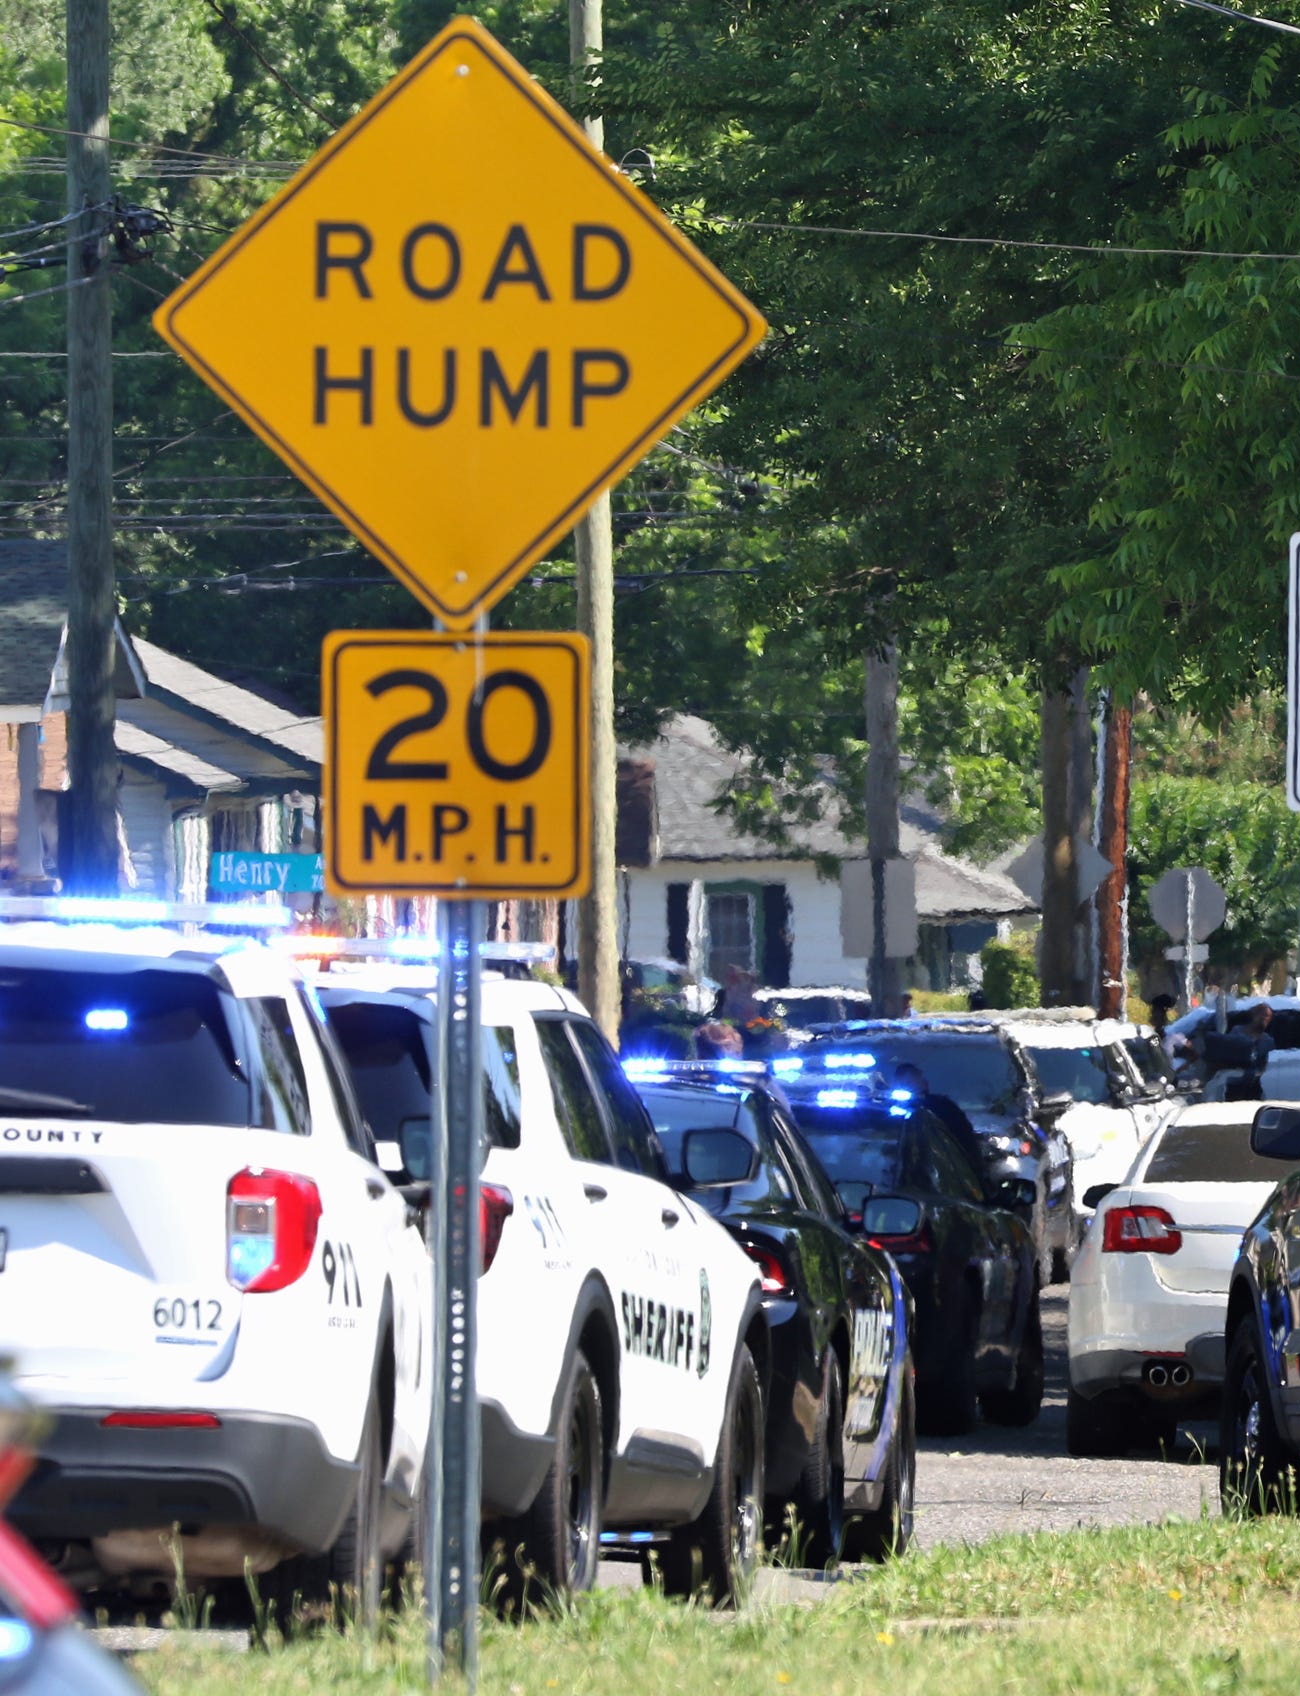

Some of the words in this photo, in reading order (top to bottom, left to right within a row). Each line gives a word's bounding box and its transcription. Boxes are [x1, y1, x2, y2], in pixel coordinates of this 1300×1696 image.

[314, 221, 633, 303] ROAD
[313, 346, 631, 429] HUMP
[364, 667, 552, 783] 20
[361, 804, 549, 864] M.P.H.
[219, 853, 291, 891] Henry
[3, 1128, 103, 1144] OUNTY
[322, 1239, 362, 1308] 911
[152, 1297, 223, 1332] 6012
[620, 1289, 694, 1371] SHERIFF
